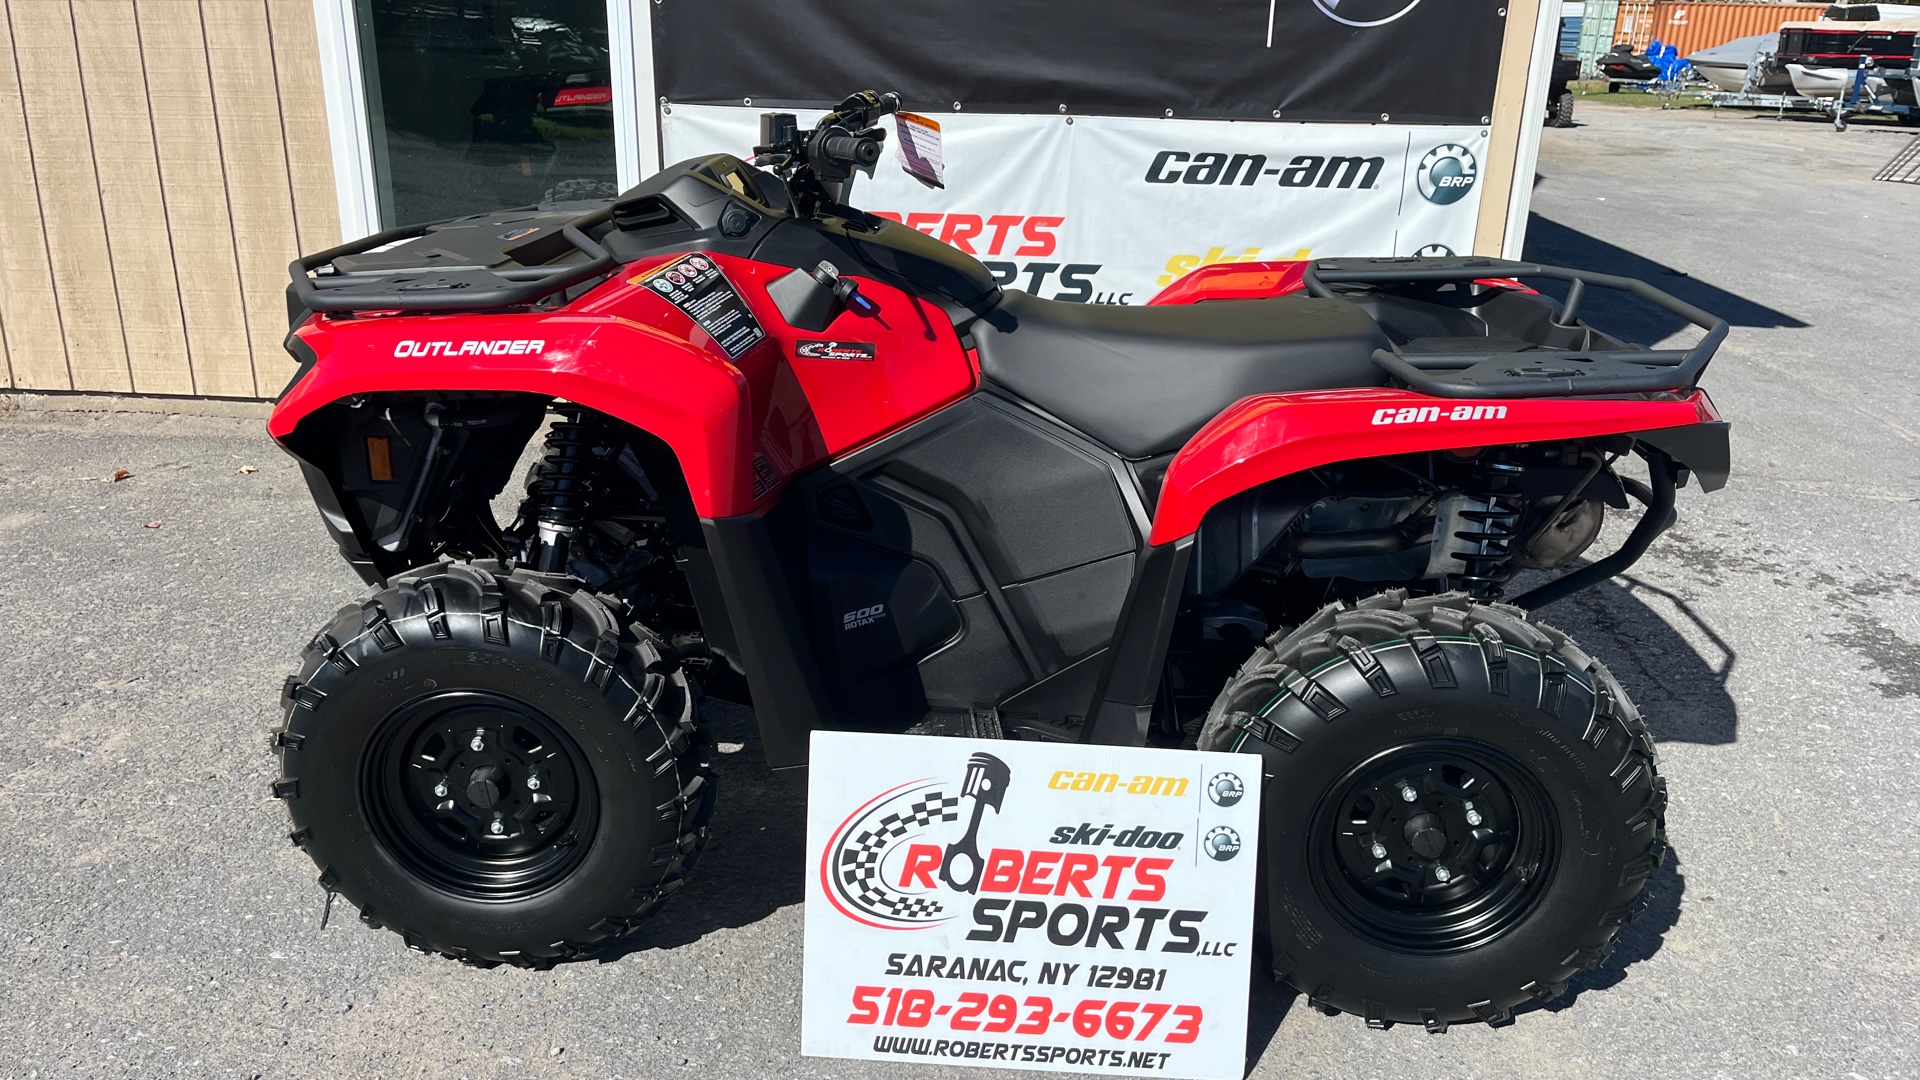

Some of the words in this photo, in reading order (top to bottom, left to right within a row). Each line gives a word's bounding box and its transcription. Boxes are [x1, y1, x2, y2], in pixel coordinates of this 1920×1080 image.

[1145, 151, 1385, 190] can-am
[1438, 175, 1474, 189] BRP
[394, 340, 545, 358] OUTLANDER
[1371, 405, 1508, 426] can-am
[844, 616, 875, 631] ROTAX
[1047, 770, 1189, 797] can-am
[1221, 790, 1243, 798] BRP
[1049, 822, 1185, 850] ski-doo
[1217, 844, 1240, 852] BRP
[898, 843, 1175, 902] ROBERTS
[885, 953, 1029, 987] SARANAC,
[1037, 963, 1080, 986] NY
[1086, 965, 1168, 991] 12981
[846, 985, 1204, 1044] 518-293-6673
[873, 1036, 1172, 1070] WWW.ROBERTSSPORTS.NET
